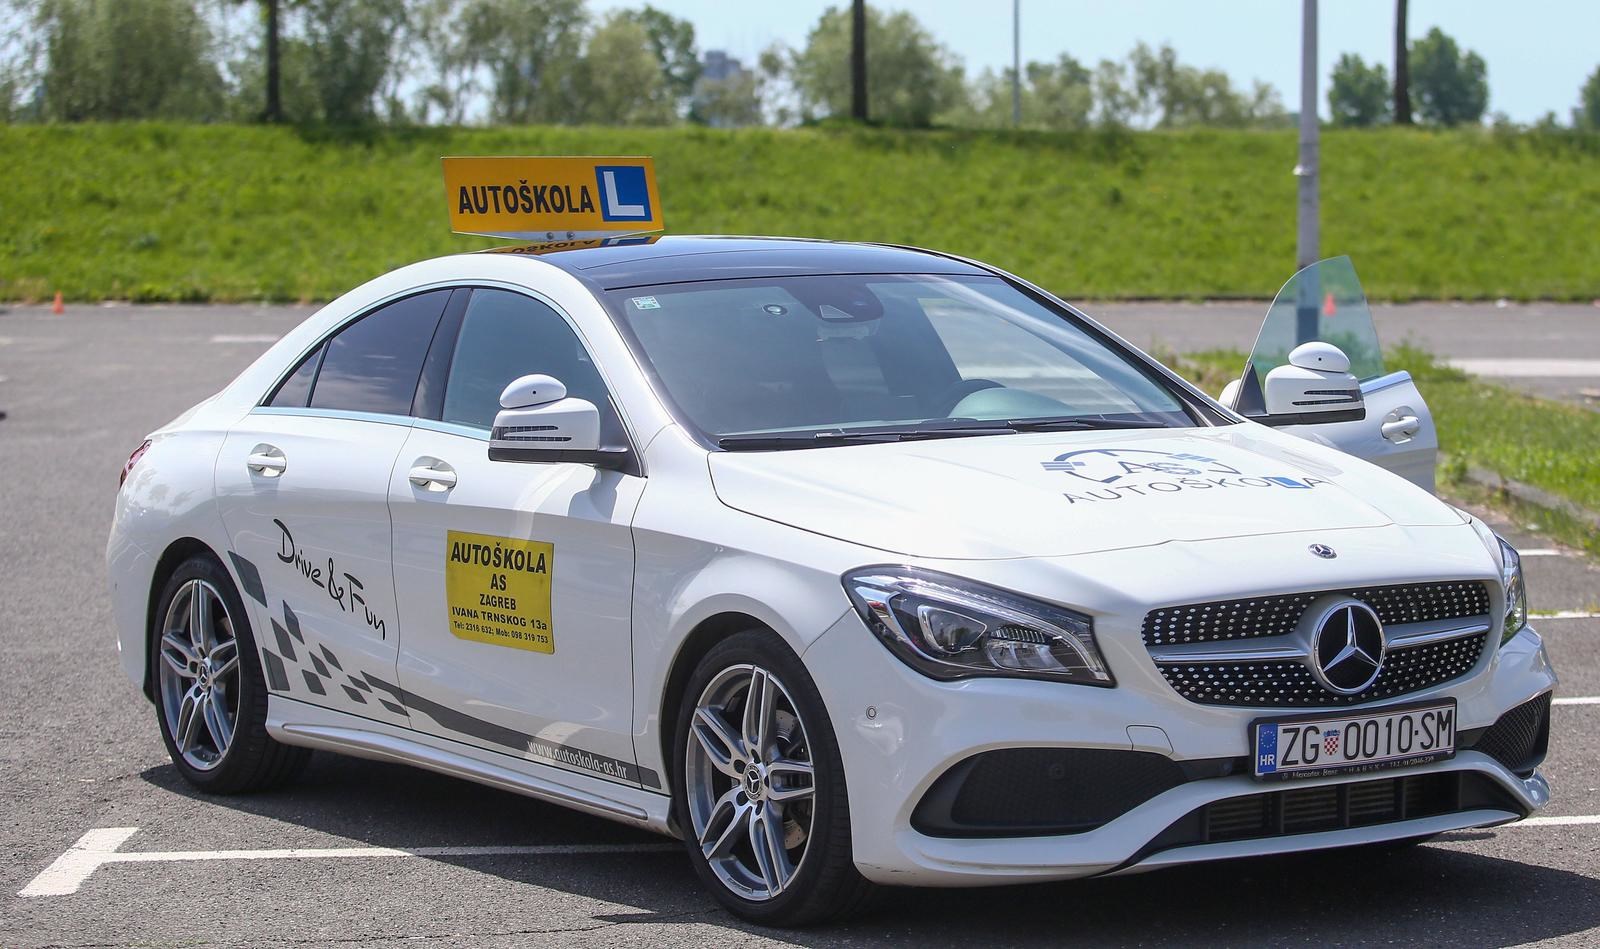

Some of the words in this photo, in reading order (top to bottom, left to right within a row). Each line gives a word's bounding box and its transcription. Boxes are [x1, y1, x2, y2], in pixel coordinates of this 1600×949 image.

[458, 180, 595, 214] AUTOŠKOLA
[603, 171, 645, 216] L
[1062, 476, 1331, 504] AUTOŠKOLA
[451, 541, 546, 574] AUTOŠKOLA
[490, 573, 507, 591] AS
[480, 593, 516, 610] ZAGREB
[452, 606, 479, 619] IVANA
[481, 611, 526, 627] TRNSKOG
[531, 619, 547, 630] 13a
[496, 628, 510, 637] Mob:
[537, 634, 548, 644] 753
[1281, 725, 1320, 766] ZG
[527, 740, 627, 779] www.autoskola-as.hr
[1259, 754, 1275, 766] HR
